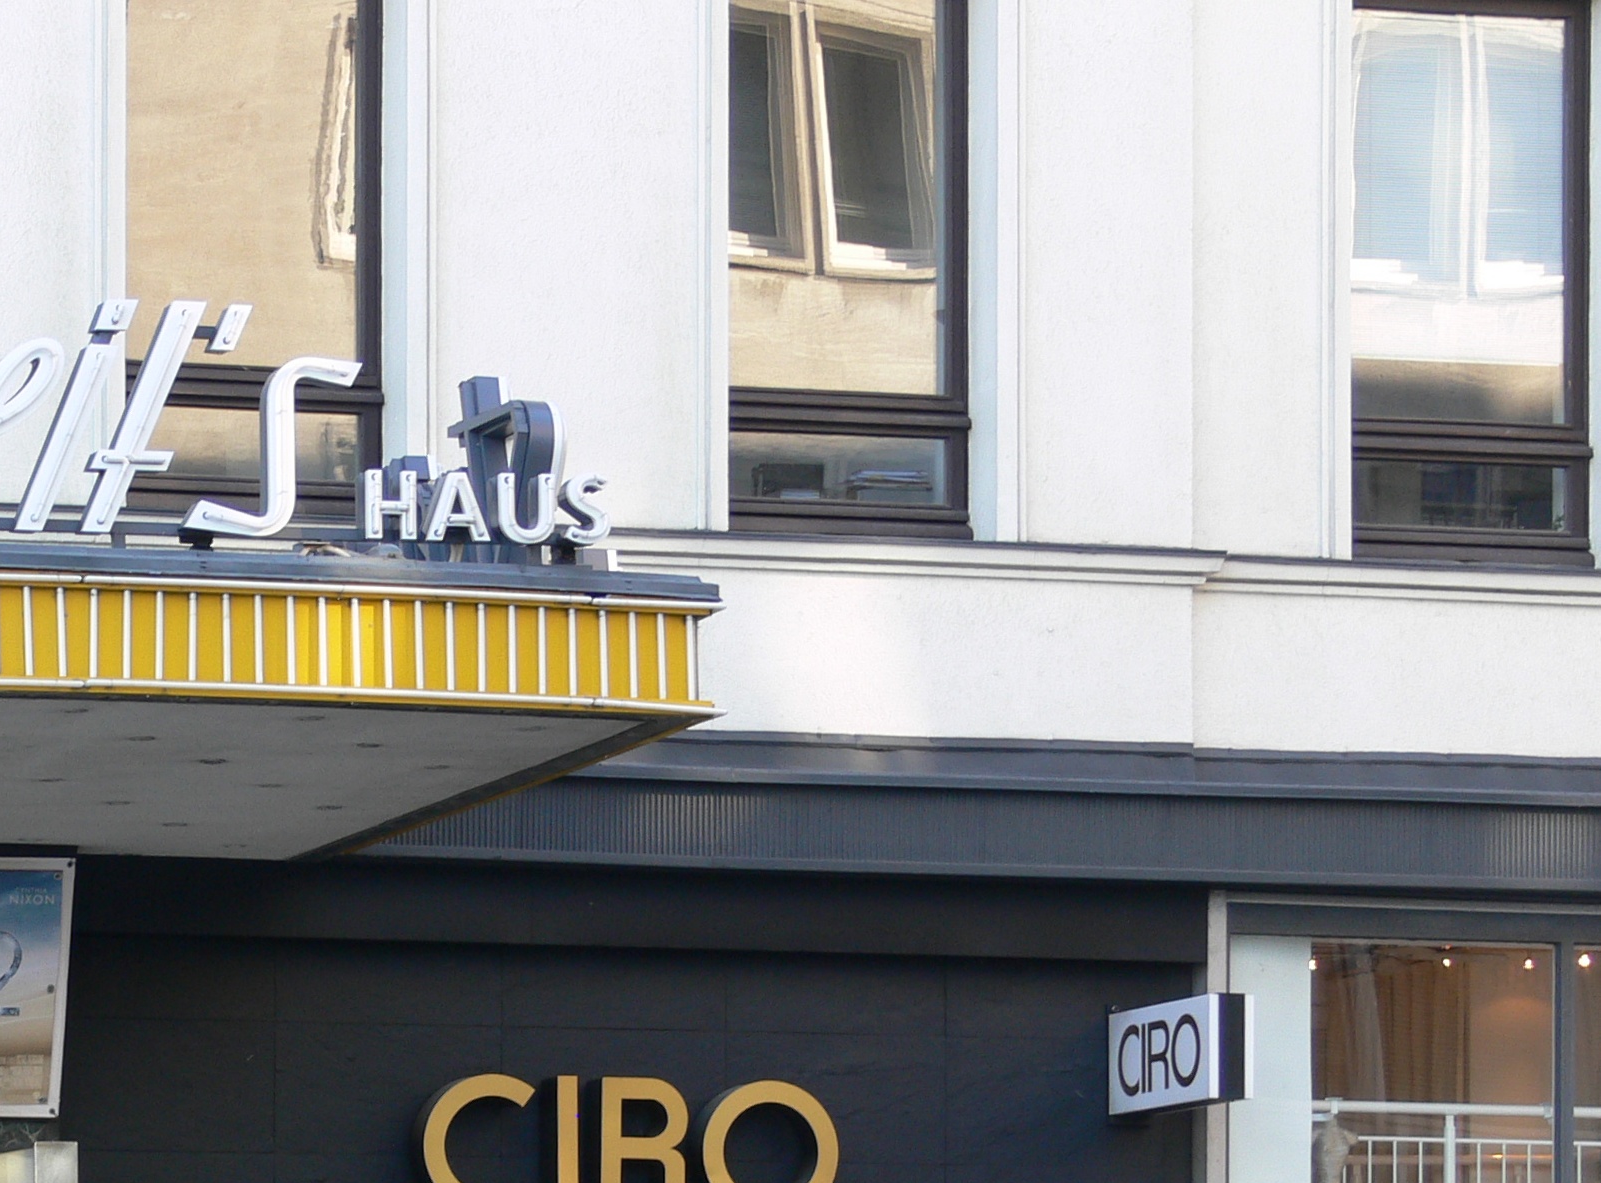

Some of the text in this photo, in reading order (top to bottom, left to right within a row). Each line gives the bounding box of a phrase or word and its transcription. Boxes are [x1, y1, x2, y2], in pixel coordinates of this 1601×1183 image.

[363, 468, 612, 546] HAUS
[9, 894, 55, 905] NIXON
[1118, 1013, 1201, 1097] CIRO
